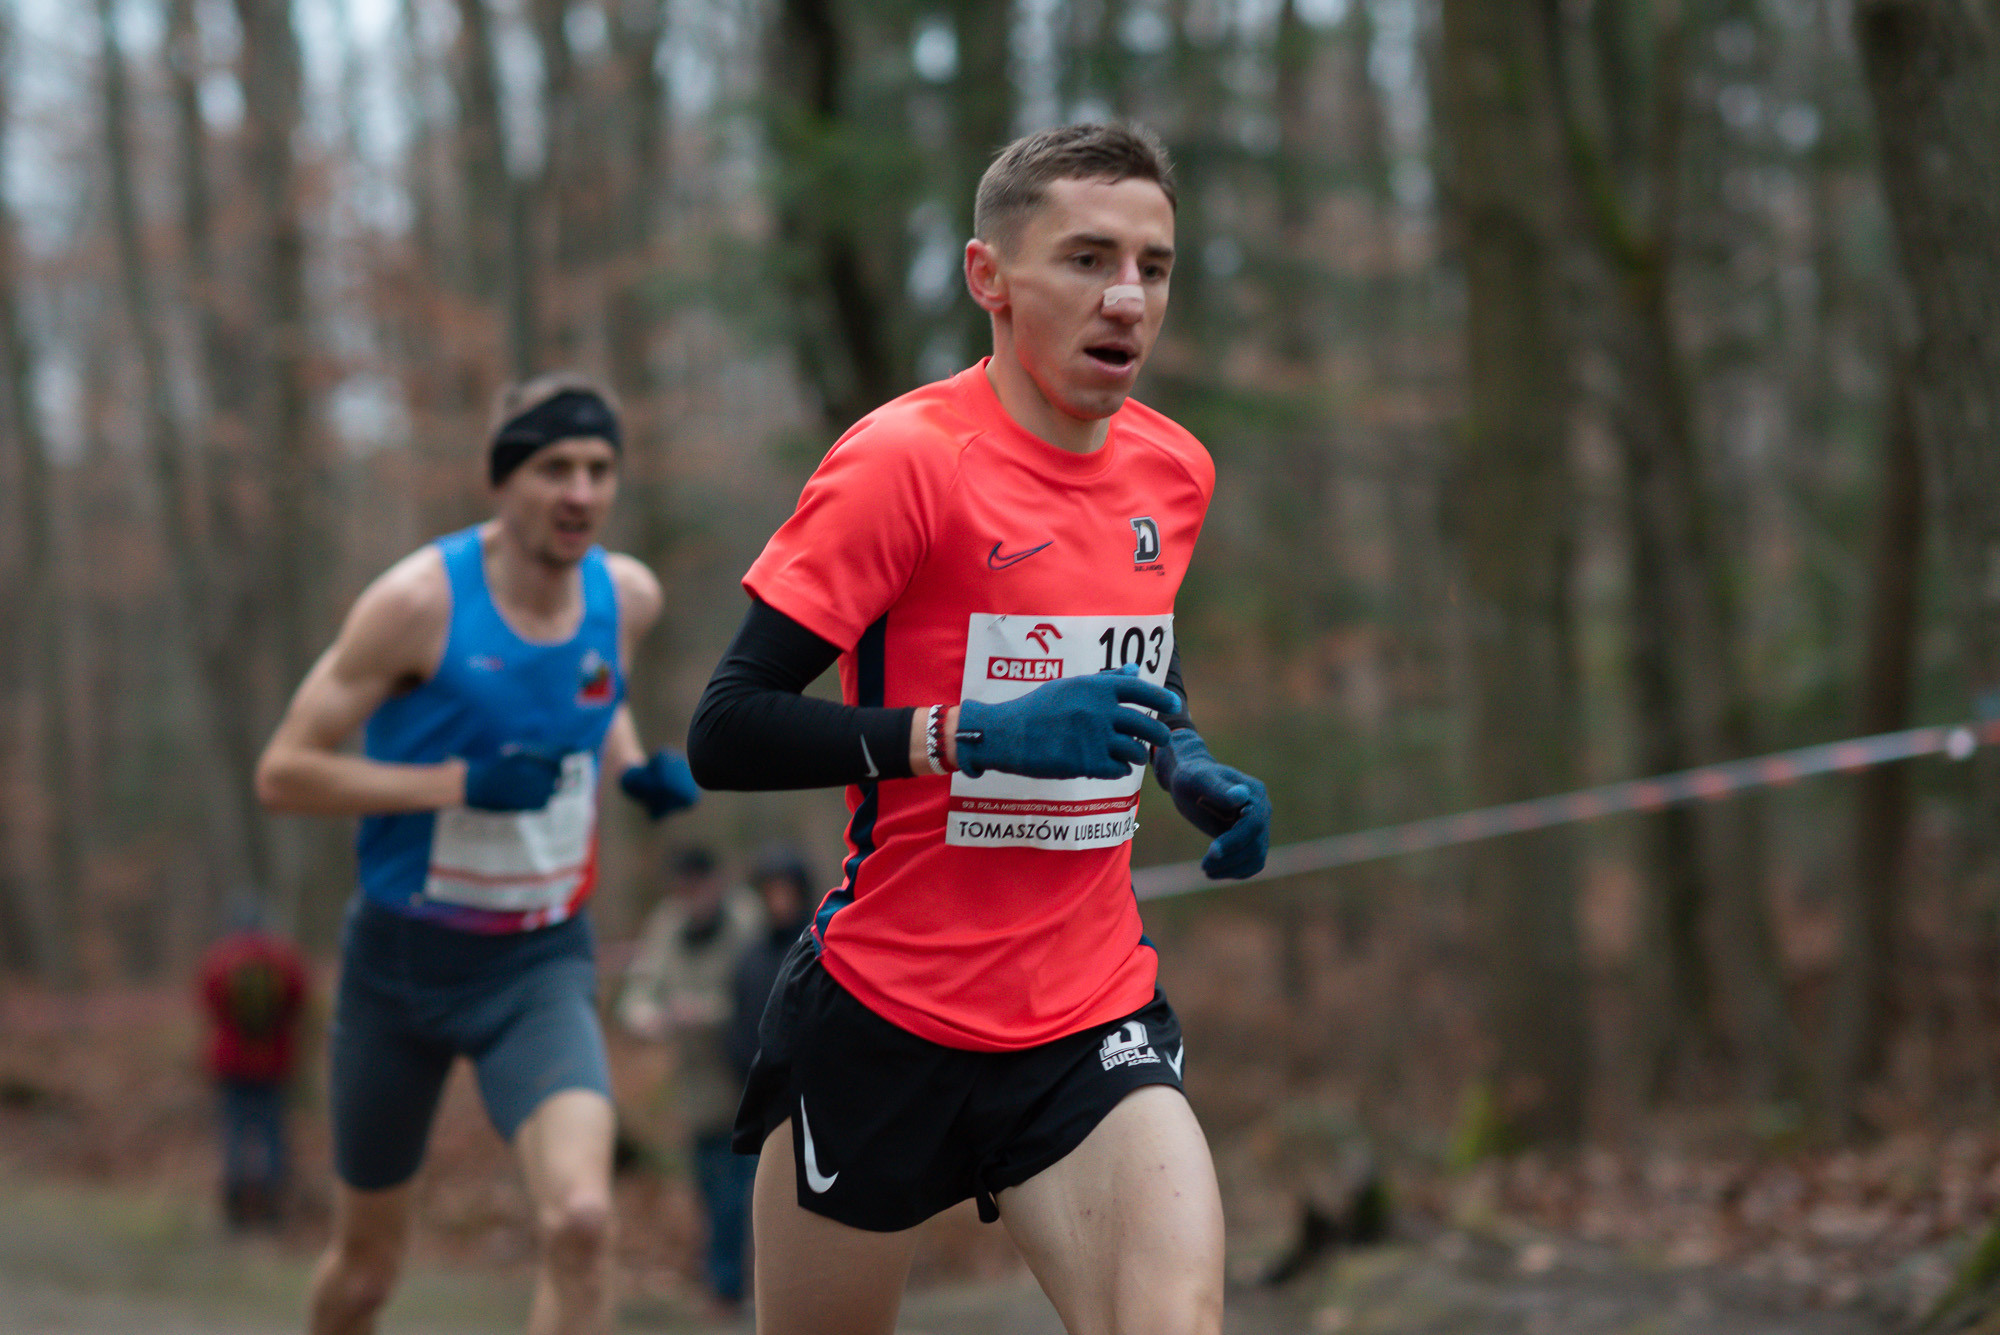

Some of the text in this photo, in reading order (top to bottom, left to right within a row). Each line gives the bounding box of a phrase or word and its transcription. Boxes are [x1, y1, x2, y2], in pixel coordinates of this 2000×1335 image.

[1099, 626, 1164, 674] 103
[991, 658, 1061, 679] ORLEN
[959, 820, 1070, 841] TOMASZÓW
[1074, 821, 1122, 841] LUBELSKI
[1101, 1046, 1160, 1071] DUCLA
